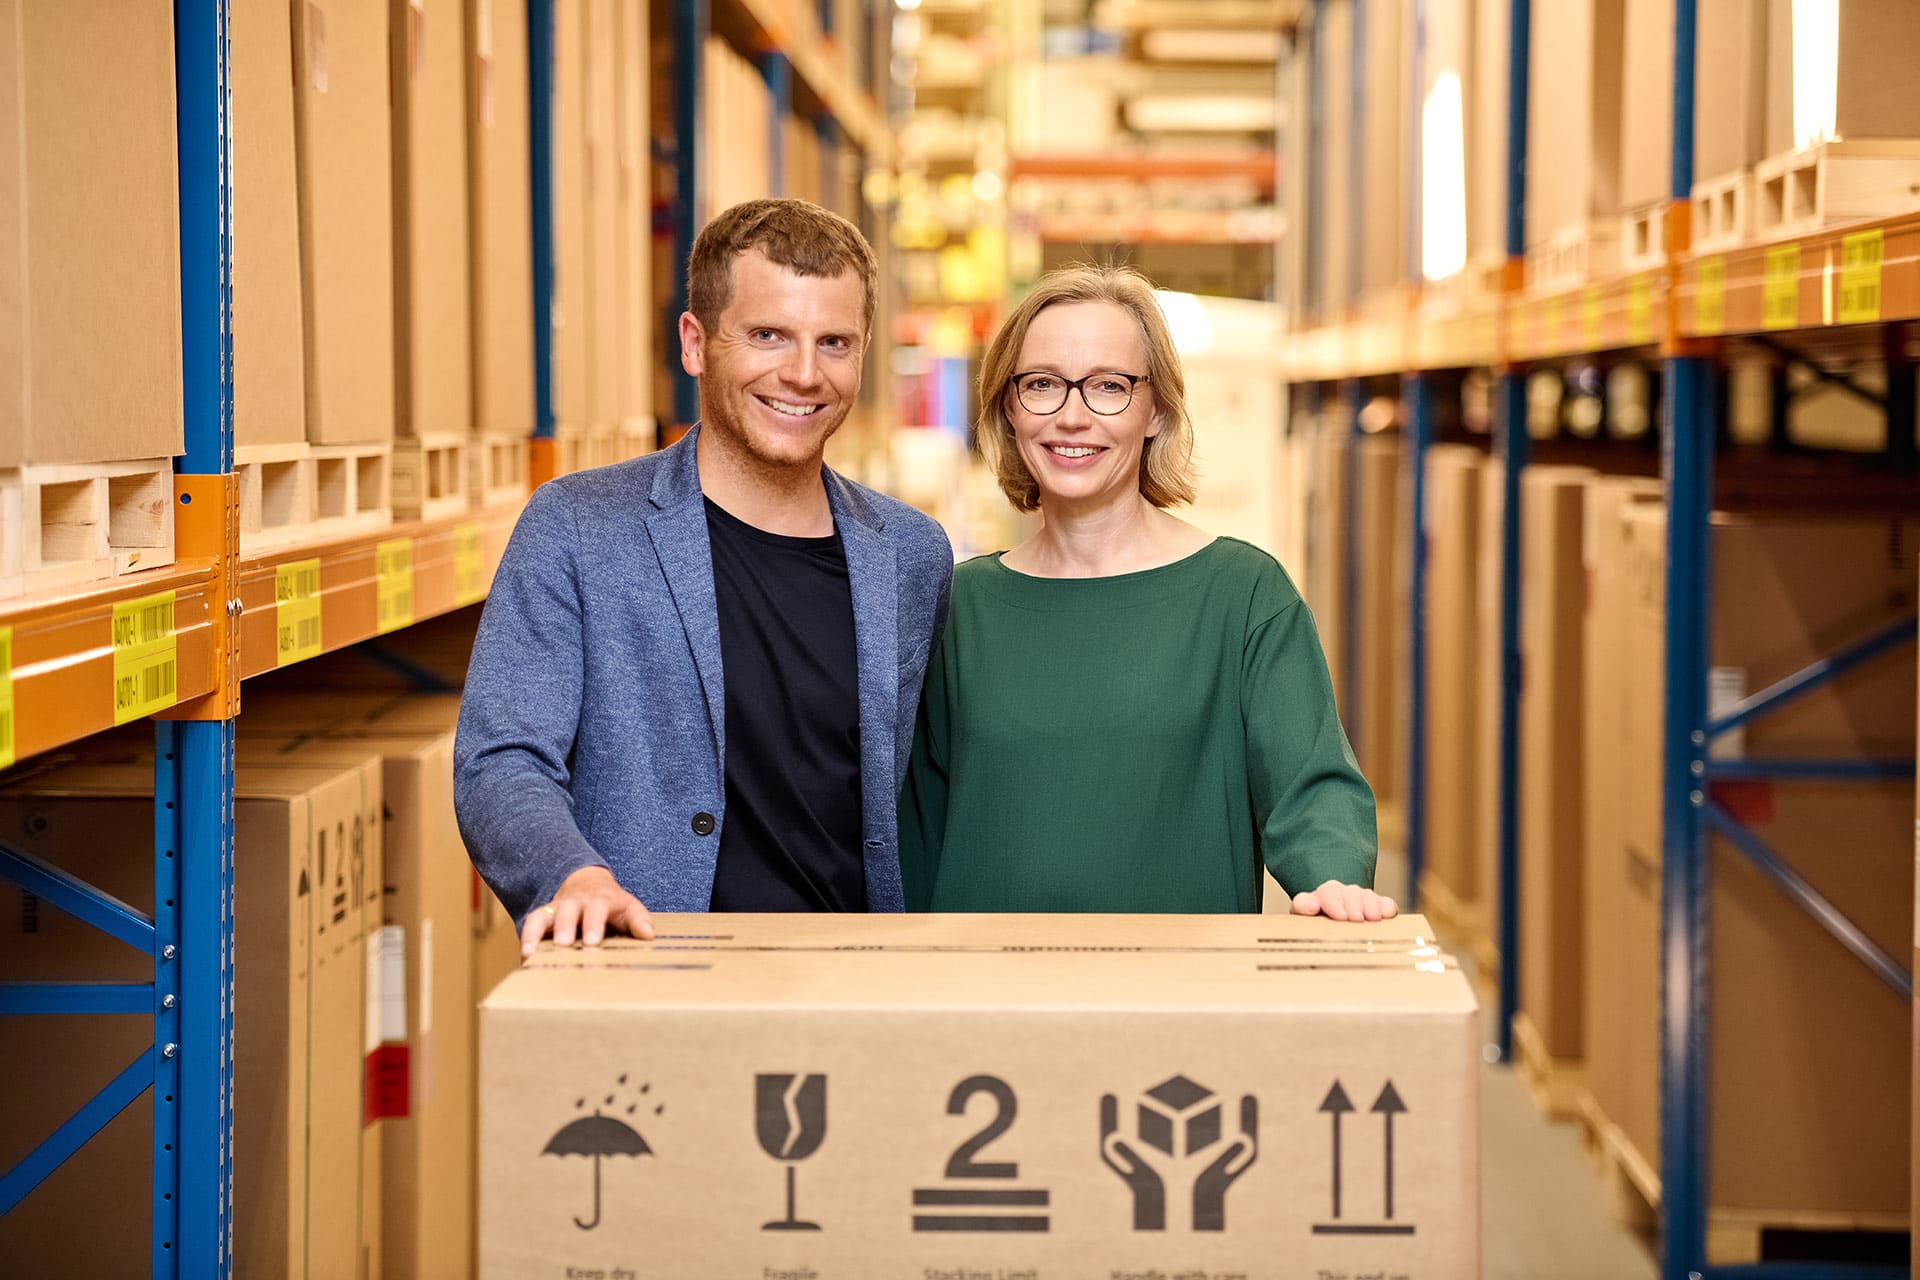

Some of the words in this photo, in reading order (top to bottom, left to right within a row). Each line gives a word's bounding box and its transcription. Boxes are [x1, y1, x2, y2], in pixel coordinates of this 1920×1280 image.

[943, 1074, 1019, 1179] 2
[566, 1267, 605, 1280] Keep
[610, 1267, 636, 1280] dry
[763, 1266, 818, 1280] Fragile
[924, 1268, 993, 1280] Stacking
[999, 1268, 1038, 1280] Limit
